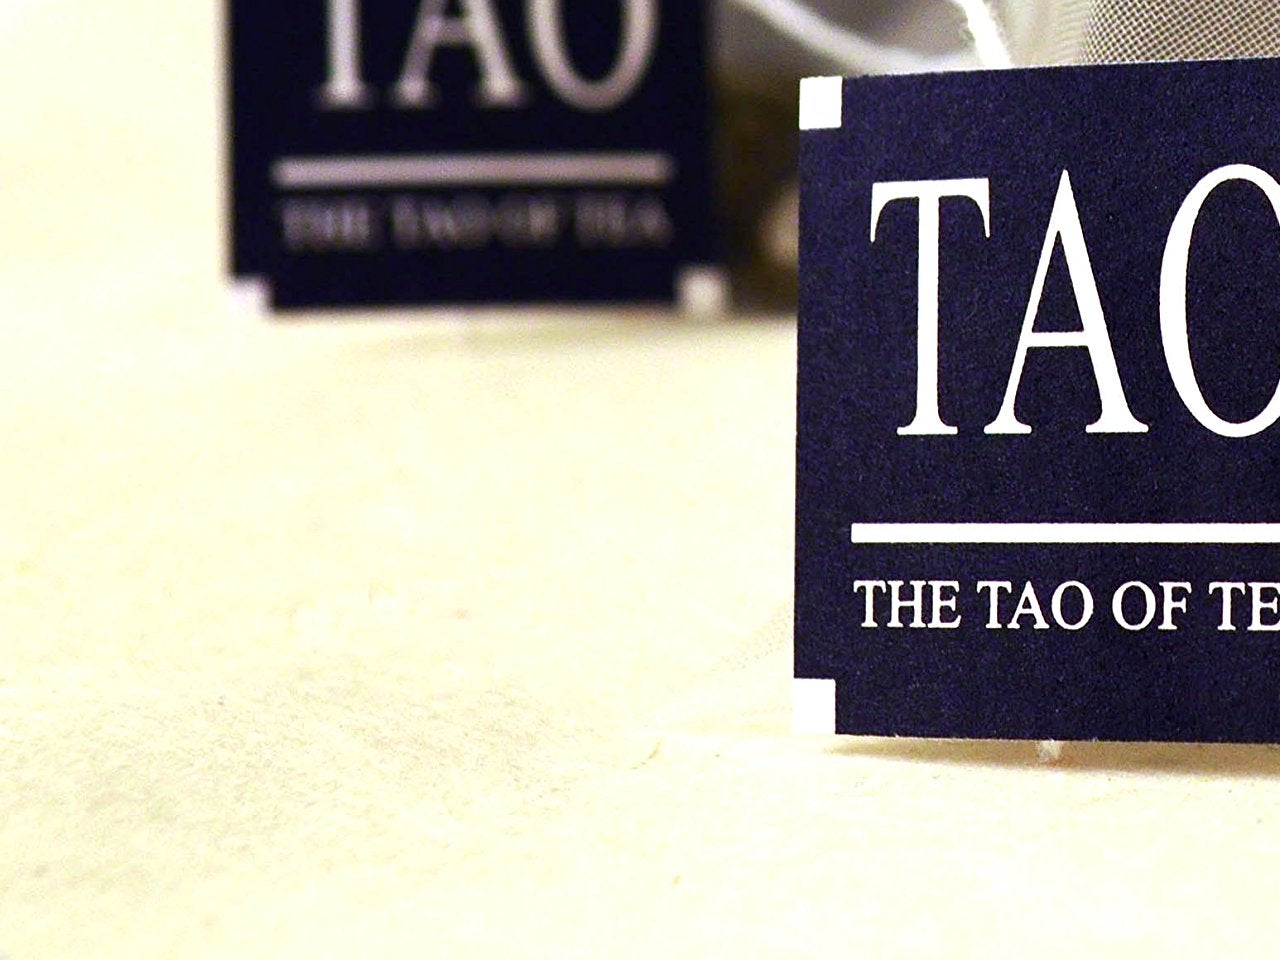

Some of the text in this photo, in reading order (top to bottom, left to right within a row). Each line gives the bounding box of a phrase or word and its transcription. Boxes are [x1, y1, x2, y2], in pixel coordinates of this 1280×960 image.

[853, 580, 961, 628] THE
[977, 580, 1093, 630] TAO
[1112, 580, 1192, 630] OF
